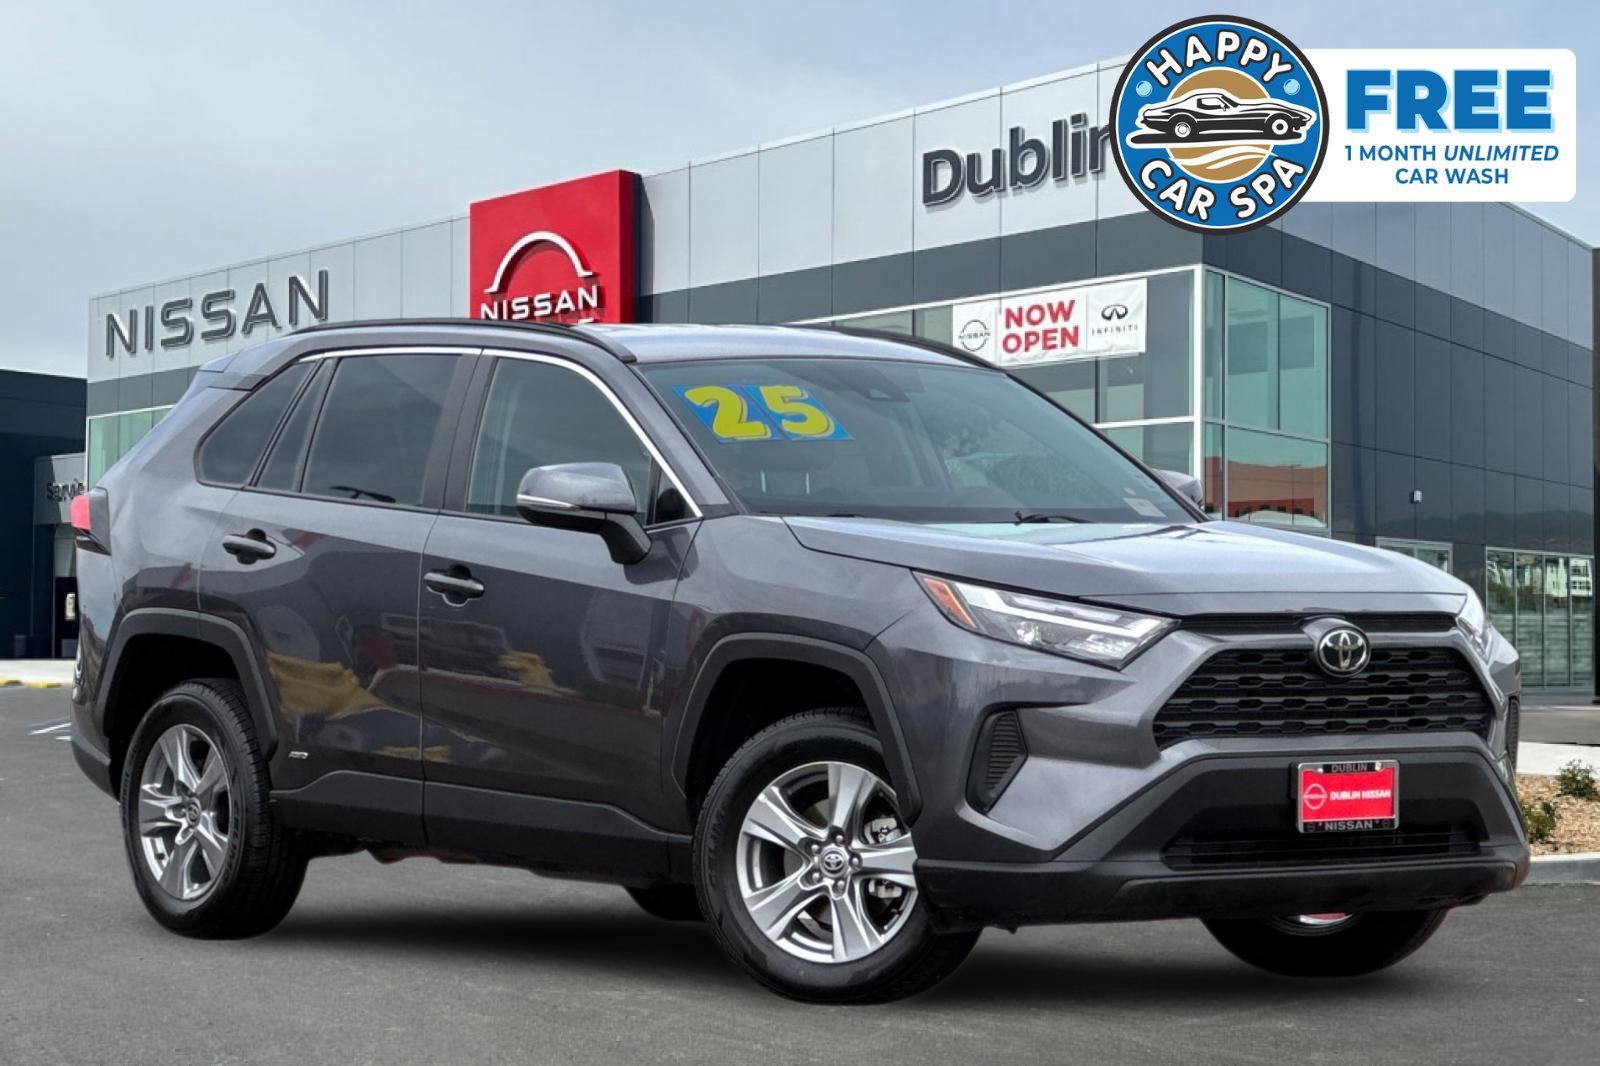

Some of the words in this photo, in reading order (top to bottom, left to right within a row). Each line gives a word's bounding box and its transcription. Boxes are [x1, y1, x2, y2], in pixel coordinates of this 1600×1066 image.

[106, 270, 328, 358] NISSAN
[480, 285, 599, 320] NISSAN
[1005, 300, 1076, 329] NOW
[1002, 325, 1080, 354] OPEN
[1091, 324, 1139, 337] INFINITI
[684, 385, 835, 439] 25
[1331, 763, 1368, 773] DUBLIN
[1330, 790, 1361, 800] DUBLIN
[1362, 789, 1392, 799] NISSAN
[1325, 820, 1373, 831] NISSAN
